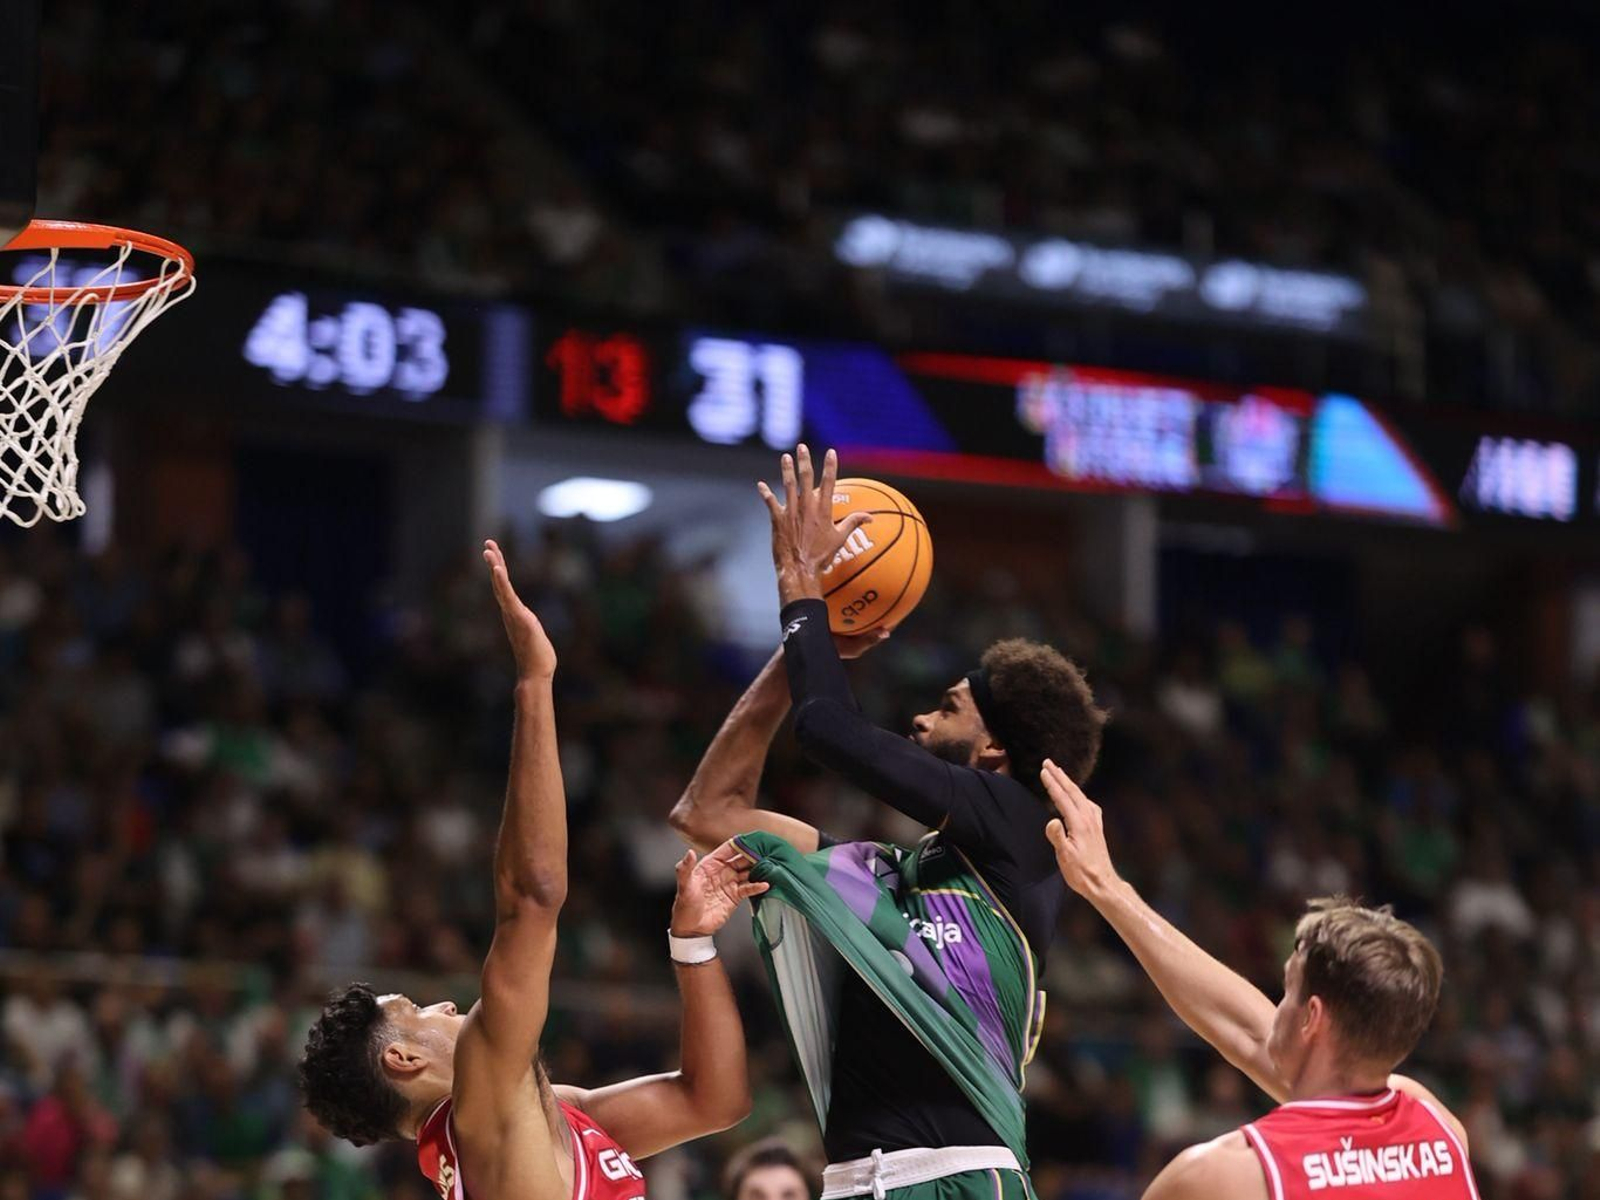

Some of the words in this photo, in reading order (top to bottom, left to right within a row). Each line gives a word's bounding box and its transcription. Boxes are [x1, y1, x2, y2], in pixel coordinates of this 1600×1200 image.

[245, 292, 449, 400] 4:03
[841, 589, 878, 619] acb
[1303, 1137, 1453, 1190] SUŠINSKAS
